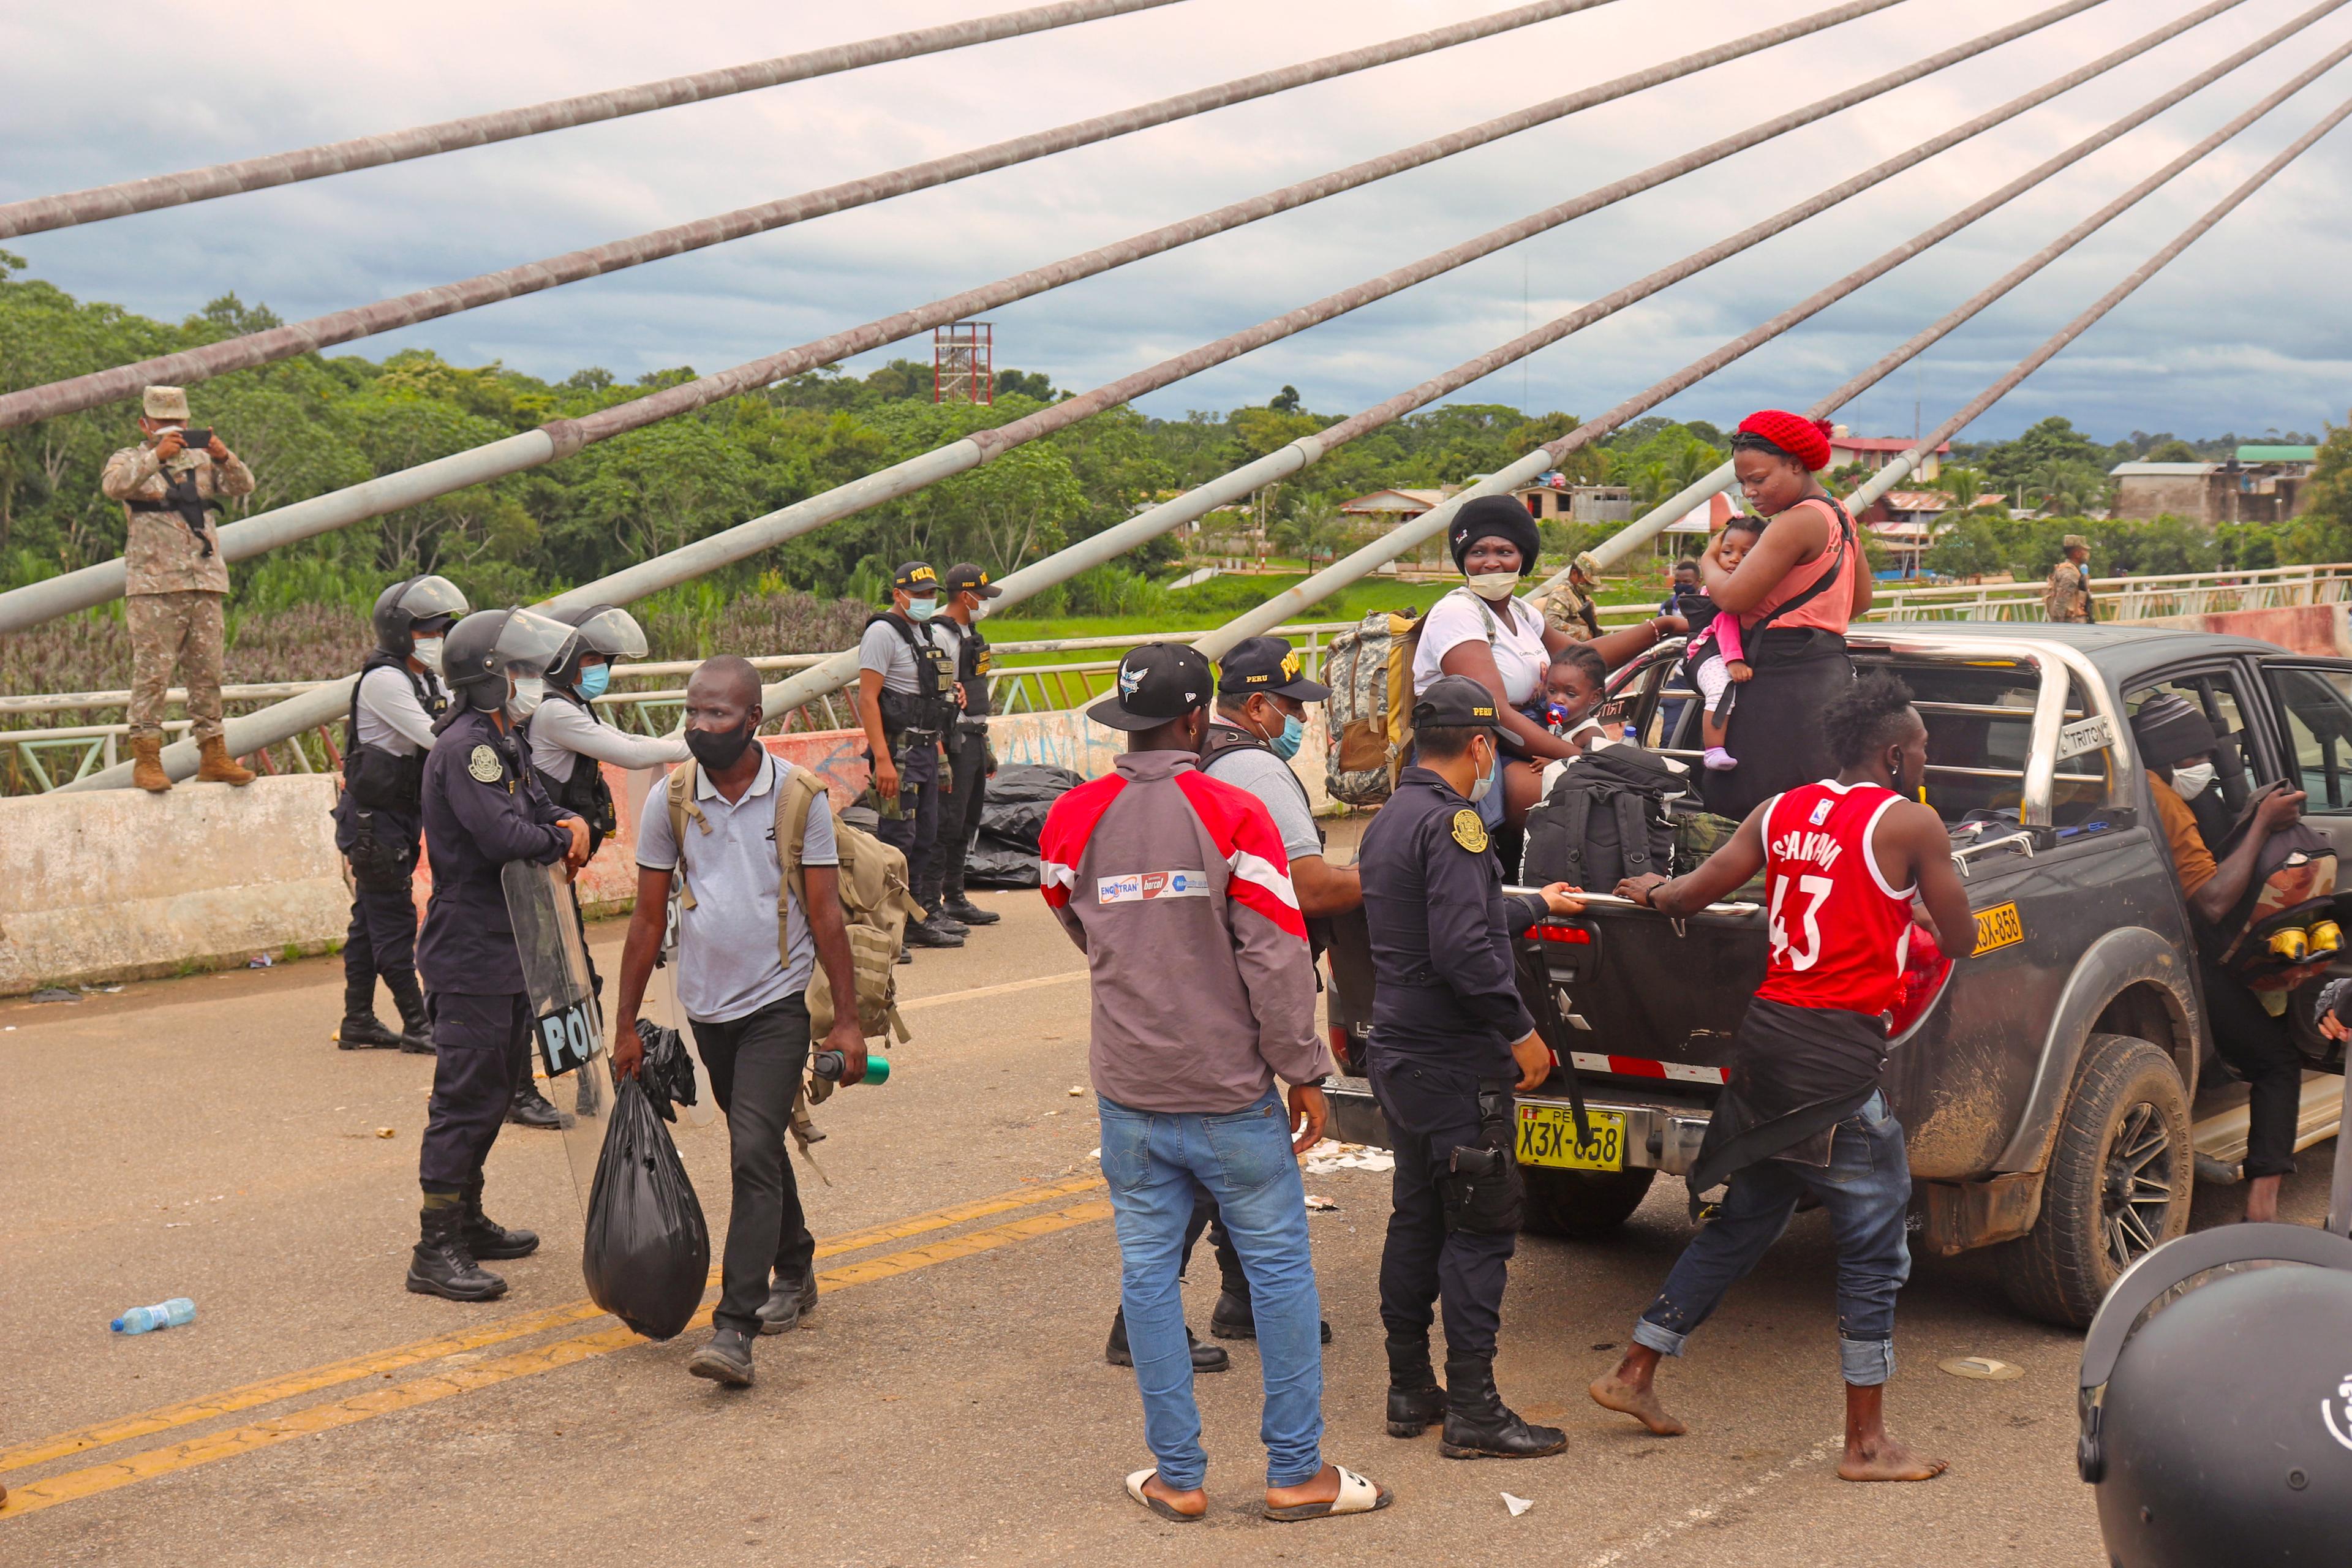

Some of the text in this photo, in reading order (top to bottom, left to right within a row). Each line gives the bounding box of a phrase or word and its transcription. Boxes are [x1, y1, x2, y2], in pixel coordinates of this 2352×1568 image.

[1246, 674, 1268, 683] PERU
[1472, 707, 1493, 716] PERU
[2070, 725, 2106, 749] TRITON
[1977, 908, 2019, 949] 3X-858
